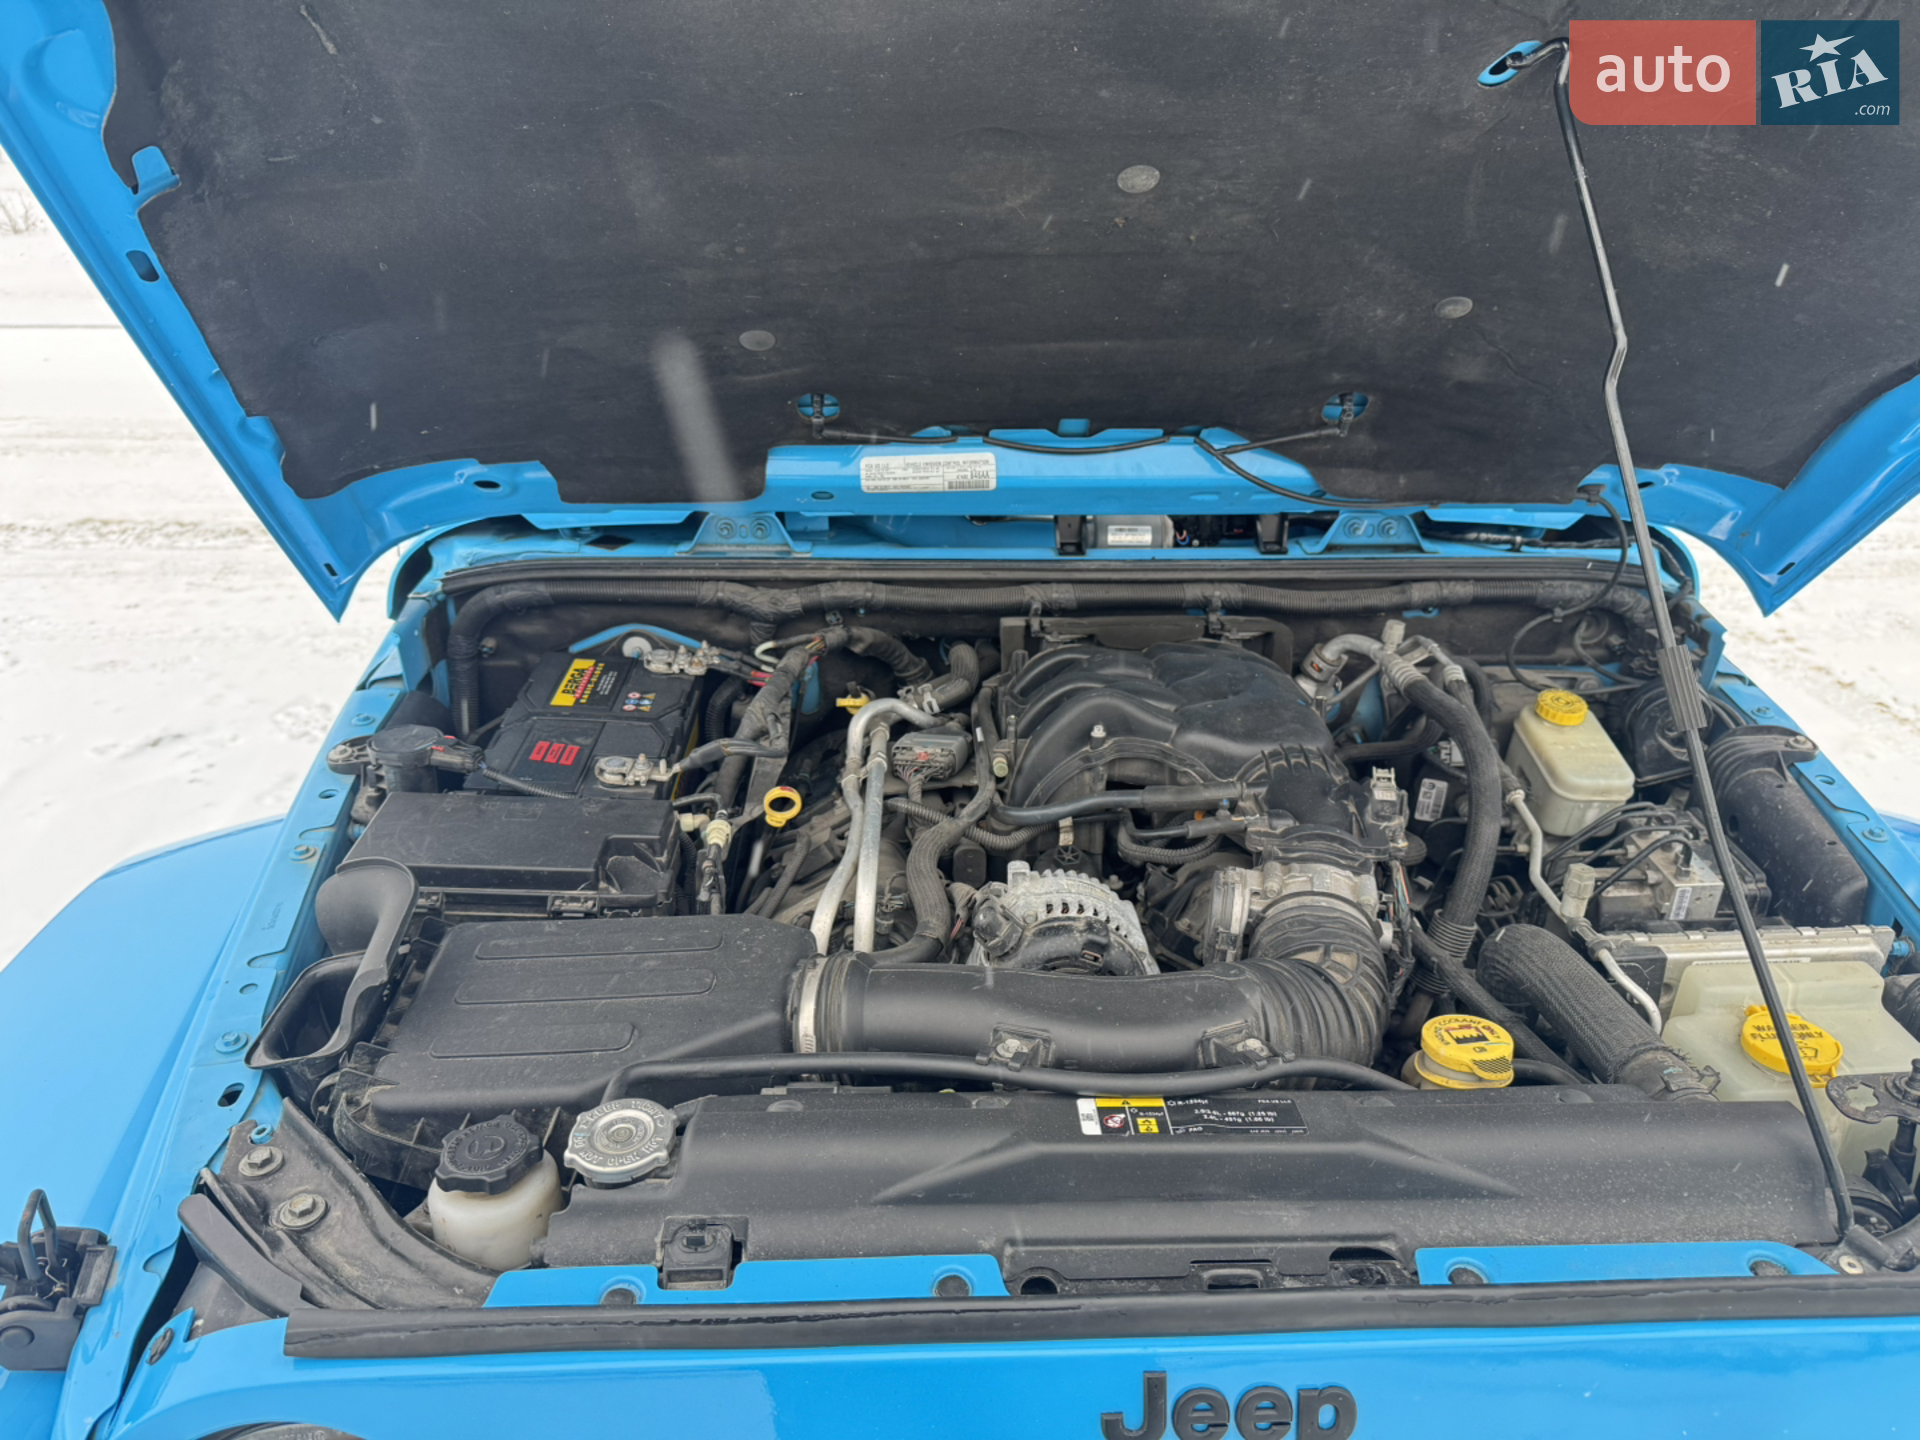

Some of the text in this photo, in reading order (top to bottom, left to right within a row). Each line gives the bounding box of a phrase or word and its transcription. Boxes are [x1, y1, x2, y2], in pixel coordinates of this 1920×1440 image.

[561, 669, 588, 694] BERGA
[1752, 1023, 1811, 1032] WAER
[1101, 1371, 1357, 1440] Jeep
